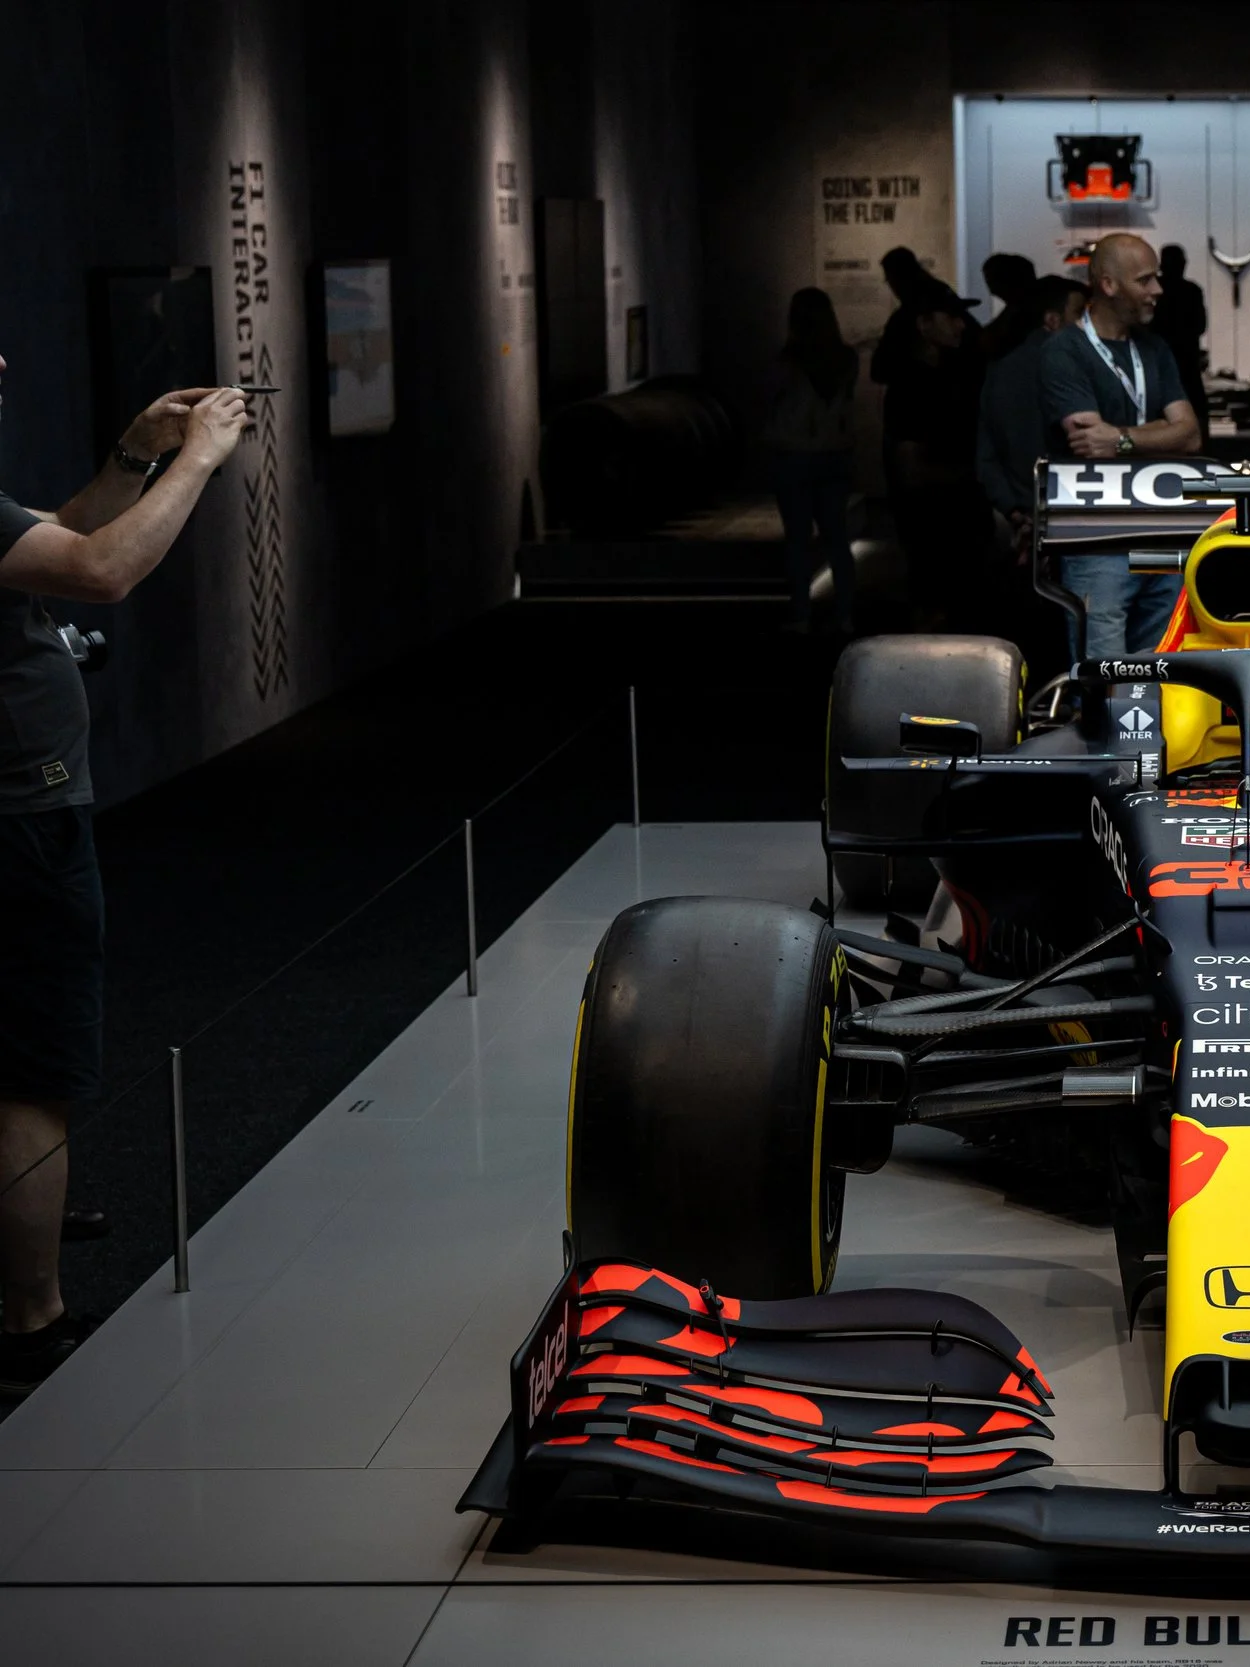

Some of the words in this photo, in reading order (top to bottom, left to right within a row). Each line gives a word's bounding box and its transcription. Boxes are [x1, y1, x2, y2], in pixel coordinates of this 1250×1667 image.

[249, 161, 264, 203] F1
[823, 177, 872, 198] GOING
[878, 175, 920, 197] WITH
[824, 203, 849, 224] THE
[855, 202, 896, 223] FLOW
[252, 223, 269, 304] CAR
[1112, 660, 1153, 677] Tezos
[1119, 731, 1153, 740] INTER
[528, 1299, 569, 1431] telcel
[1004, 1616, 1116, 1647] RED
